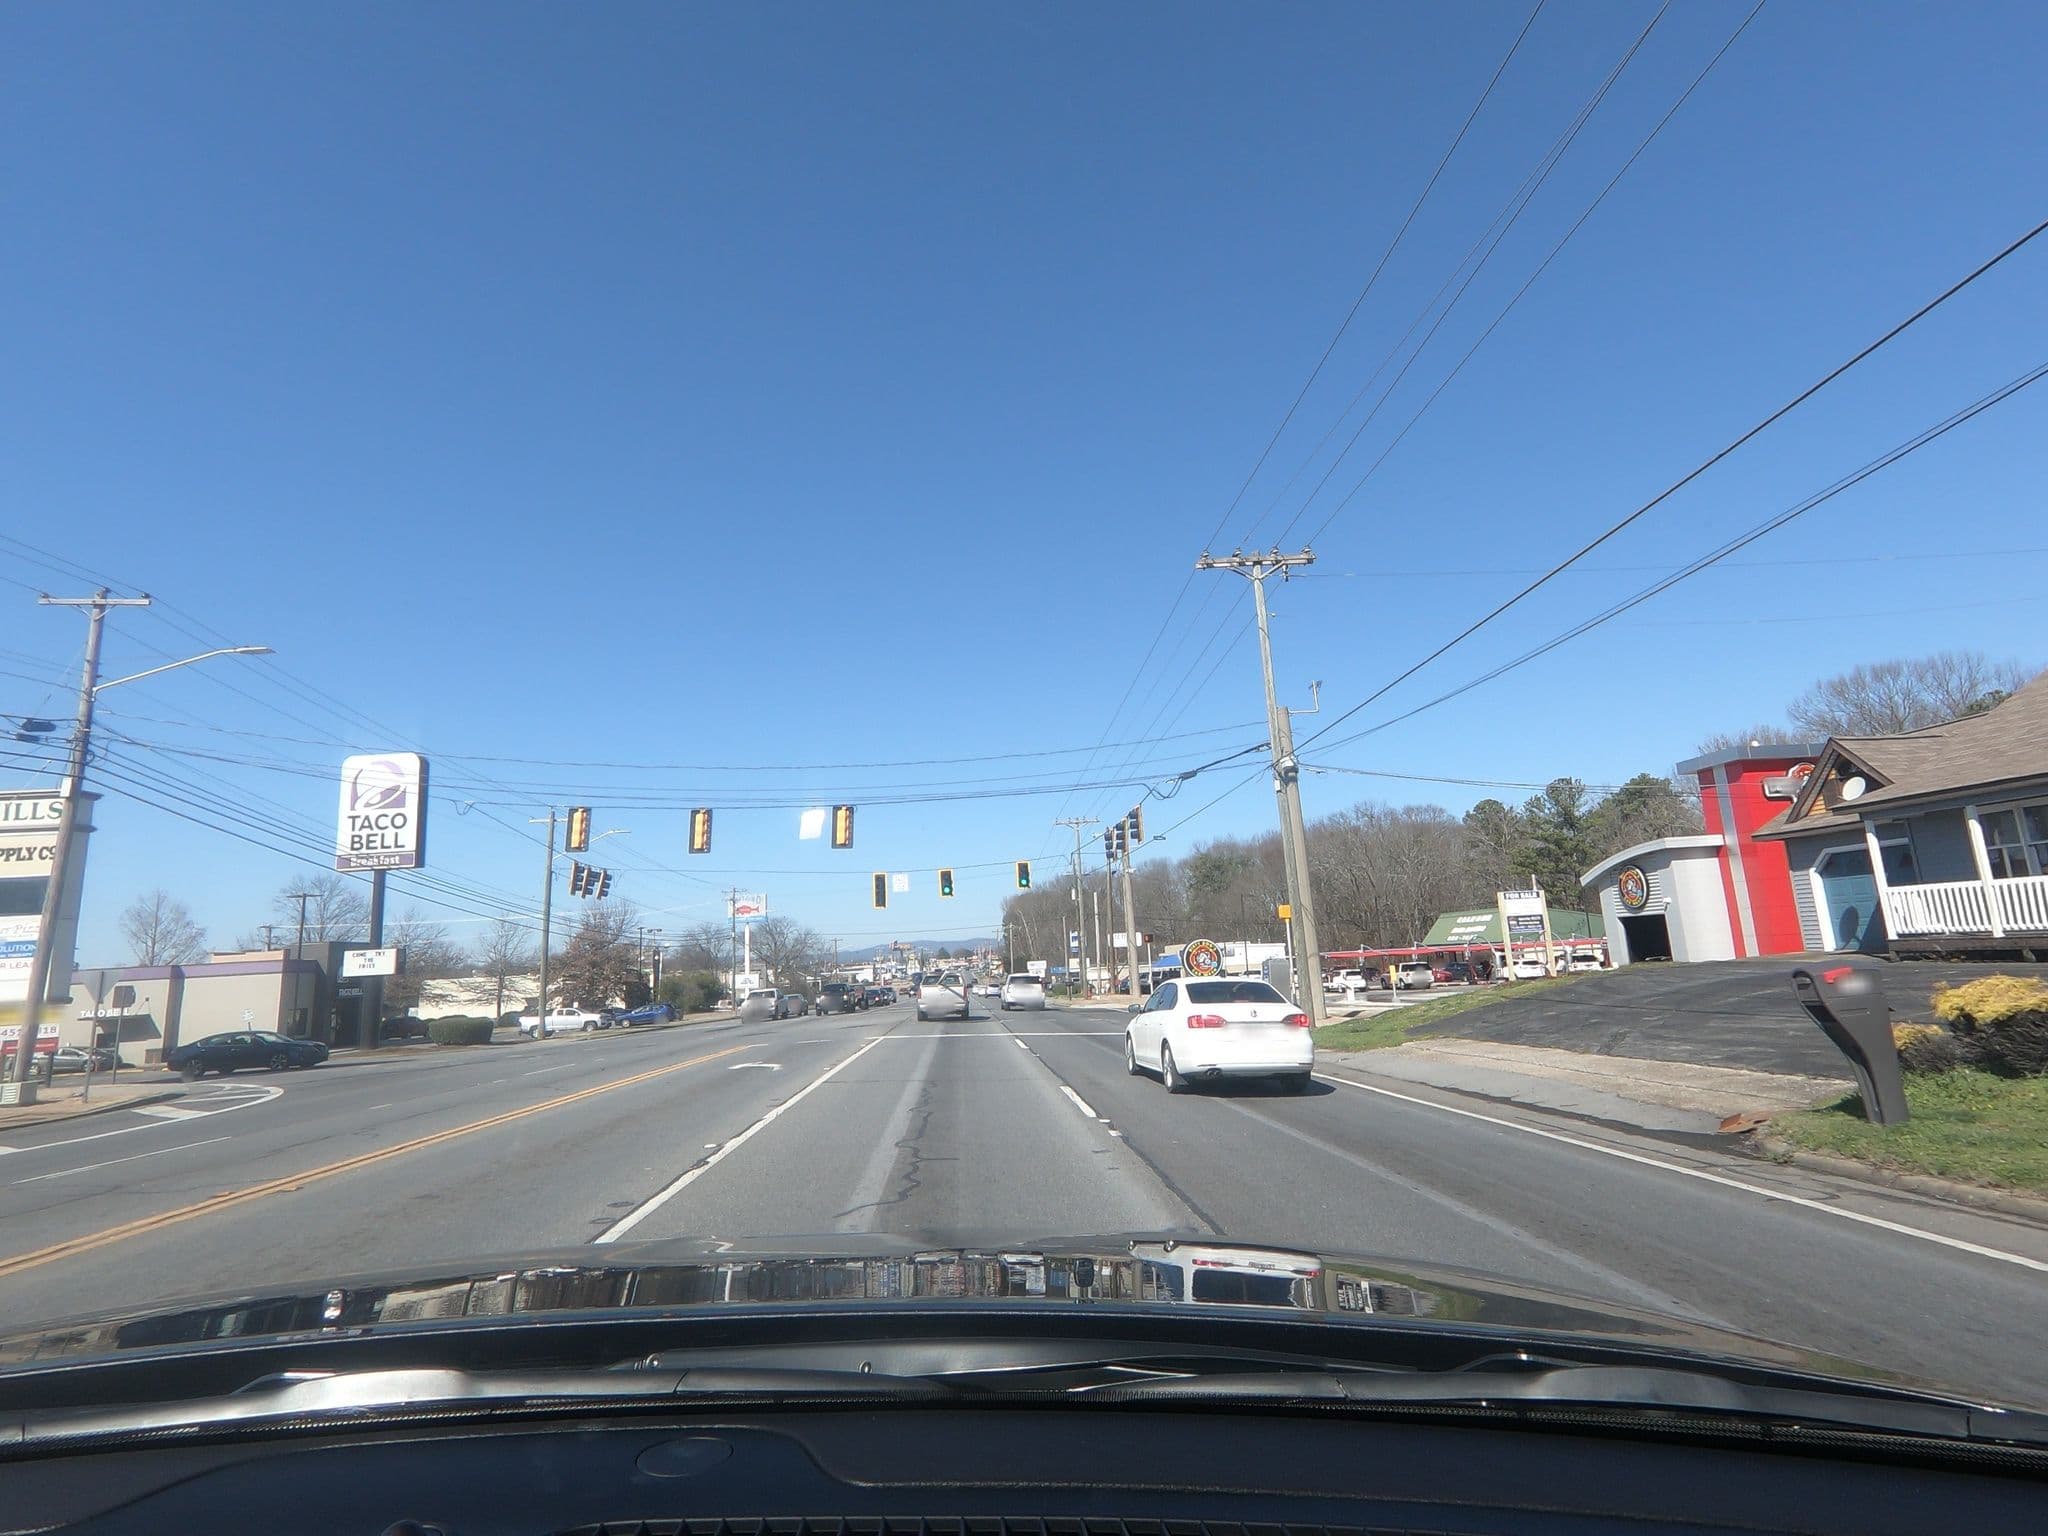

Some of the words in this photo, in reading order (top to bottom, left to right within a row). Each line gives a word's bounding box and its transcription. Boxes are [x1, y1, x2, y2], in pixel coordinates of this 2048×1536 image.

[347, 812, 408, 832] TACO
[350, 832, 406, 851] BELL
[350, 855, 400, 867] Breakfast
